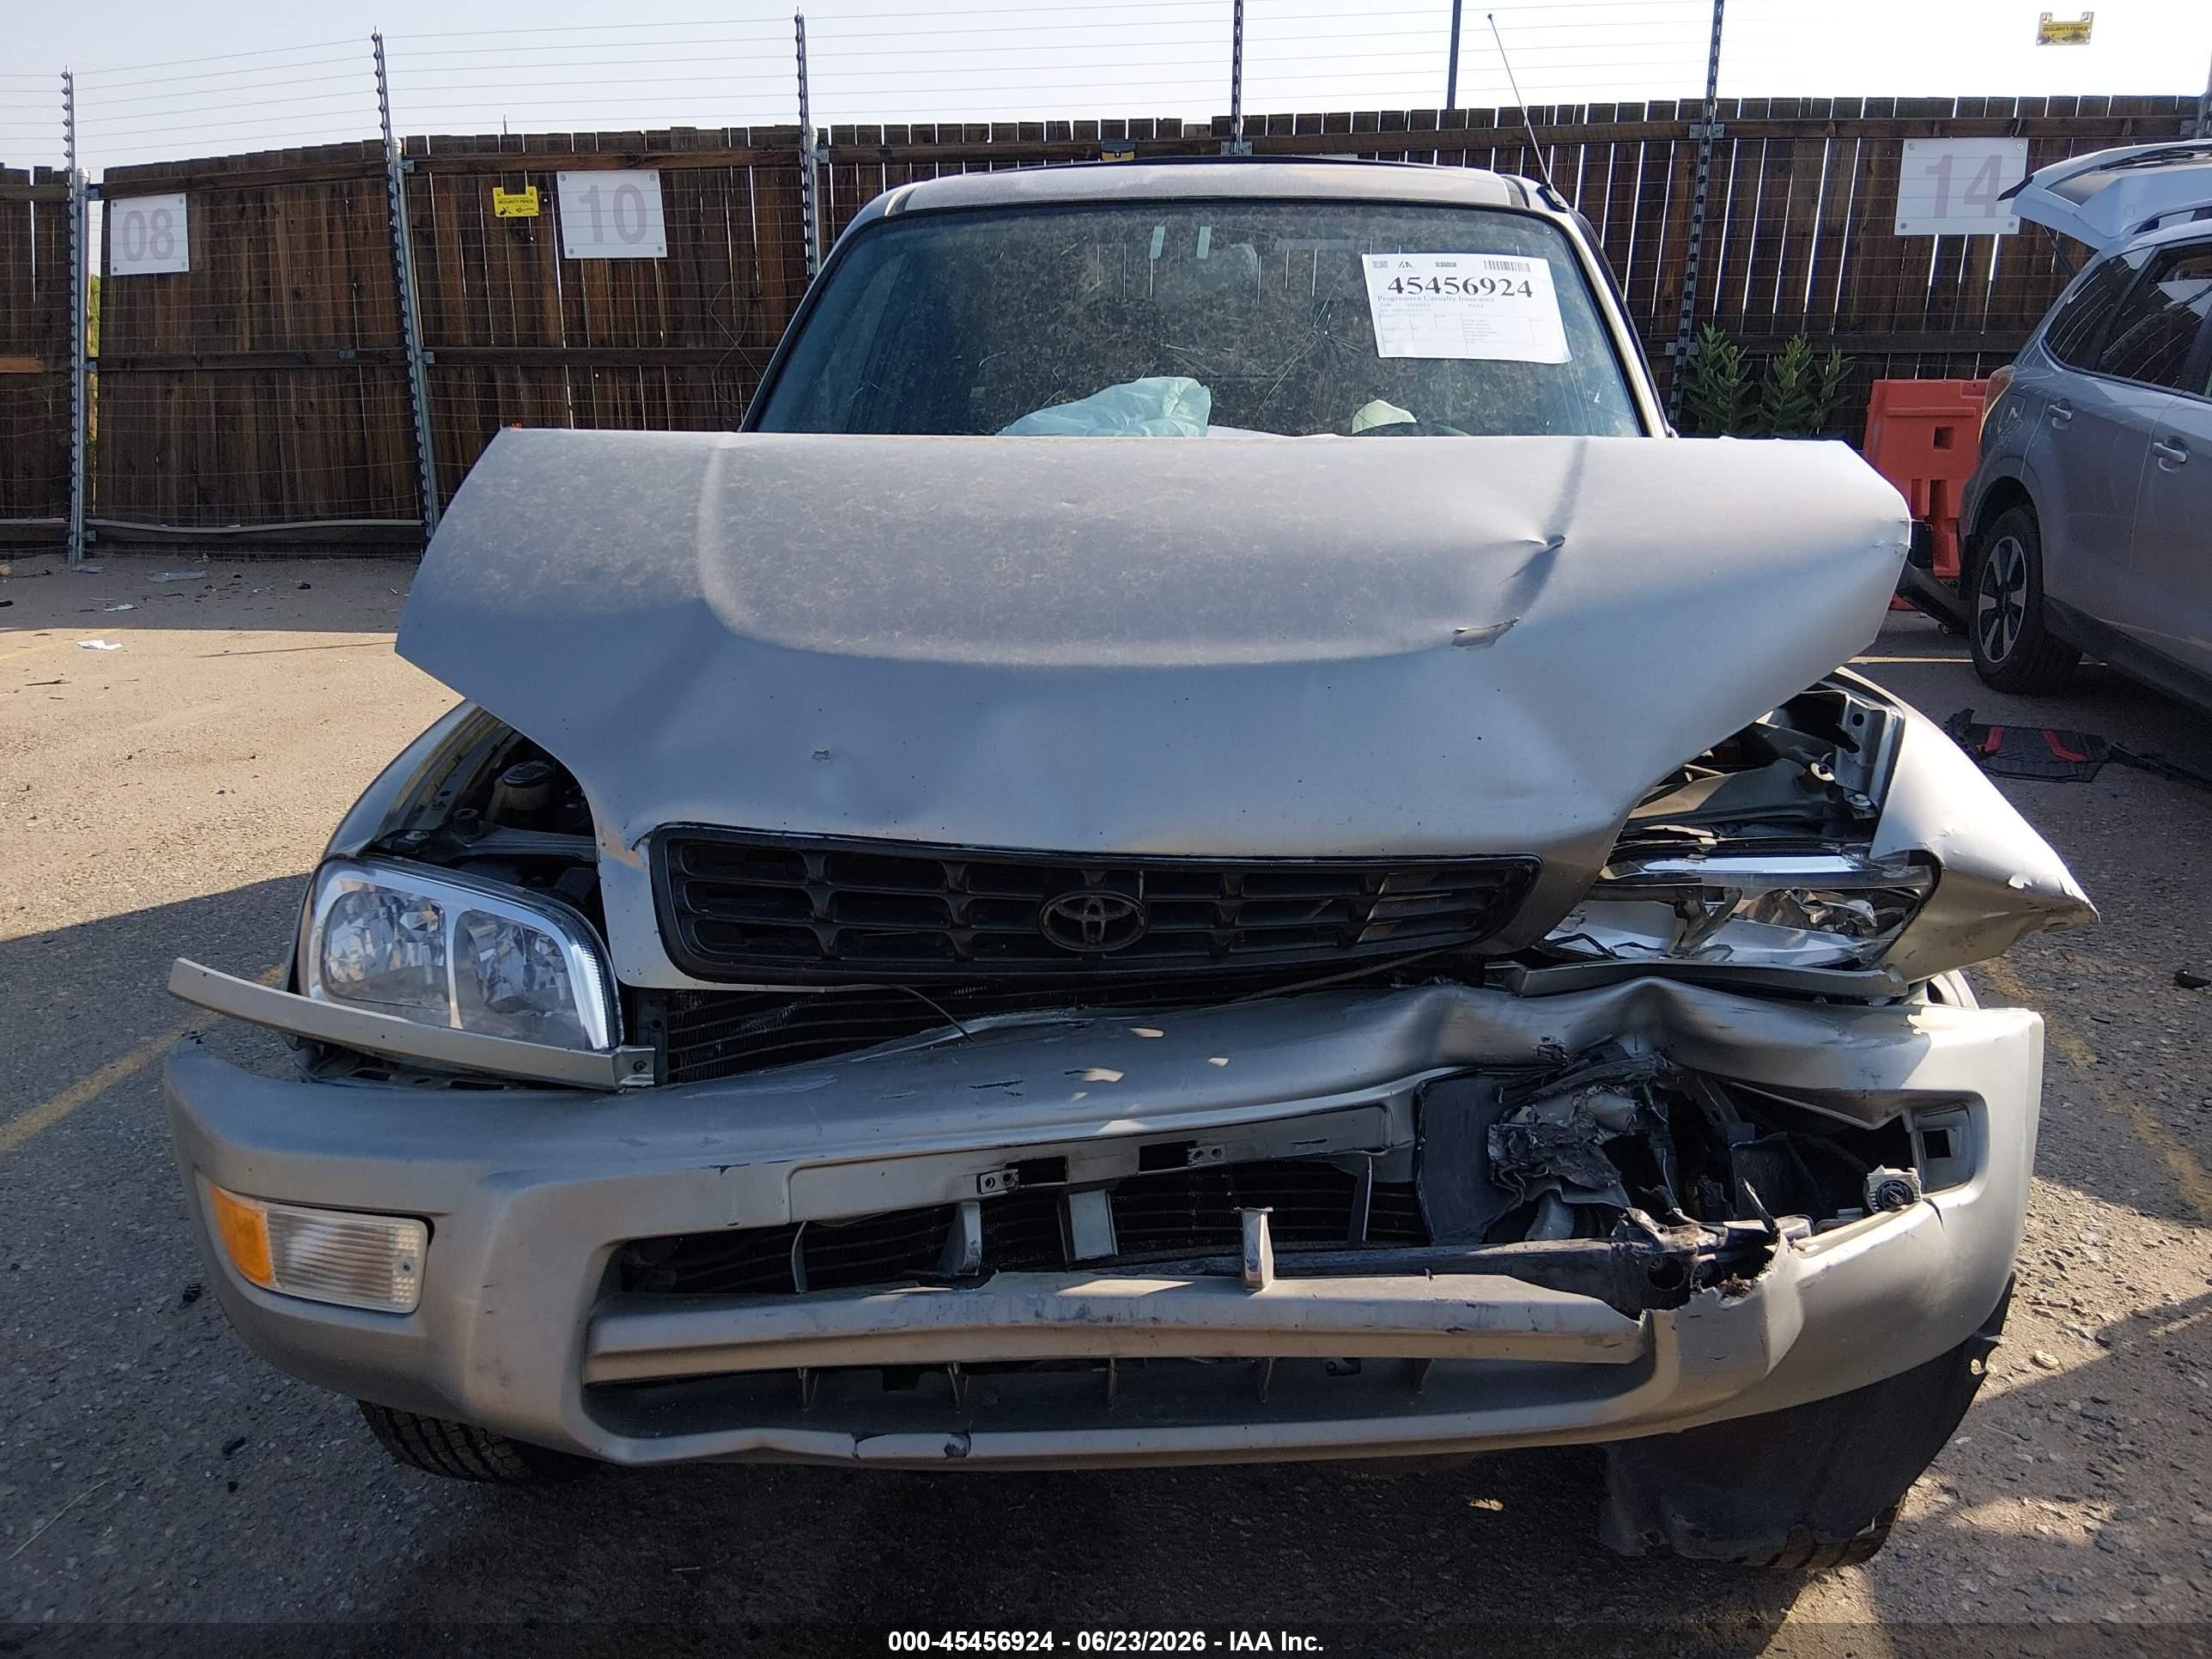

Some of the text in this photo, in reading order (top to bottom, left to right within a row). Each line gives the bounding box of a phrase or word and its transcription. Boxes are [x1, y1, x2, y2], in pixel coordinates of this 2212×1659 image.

[578, 184, 647, 245] 10
[1924, 154, 2002, 218] 14
[123, 209, 174, 262] 08
[1388, 276, 1533, 298] 45456924
